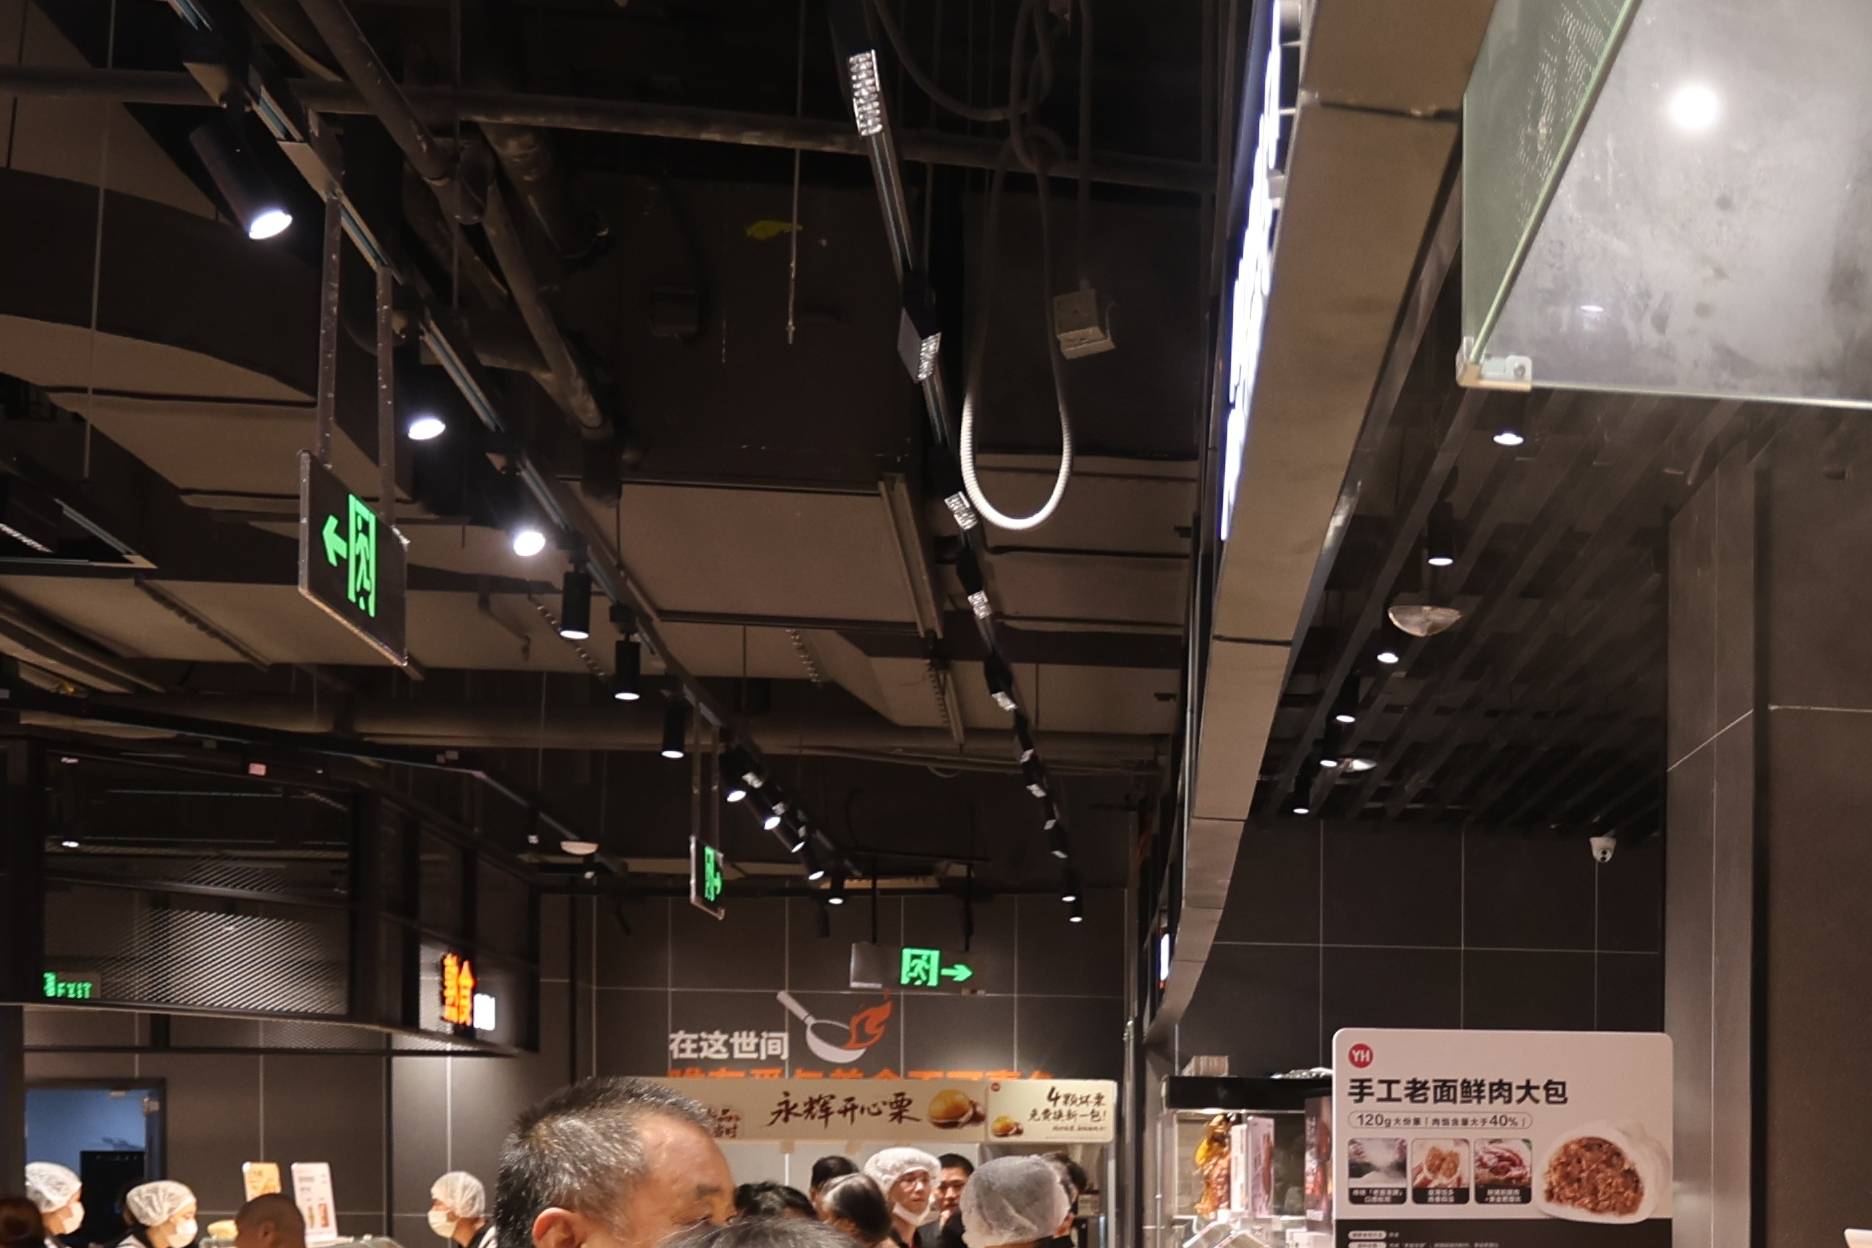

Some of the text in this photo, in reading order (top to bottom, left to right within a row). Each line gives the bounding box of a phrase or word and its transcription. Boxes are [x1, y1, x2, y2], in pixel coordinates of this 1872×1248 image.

[669, 1030, 788, 1060] 在这世间
[1351, 1050, 1370, 1062] YH
[1348, 1077, 1569, 1105] 手工老面鲜肉大包
[766, 1091, 922, 1128] 永辉开心栗
